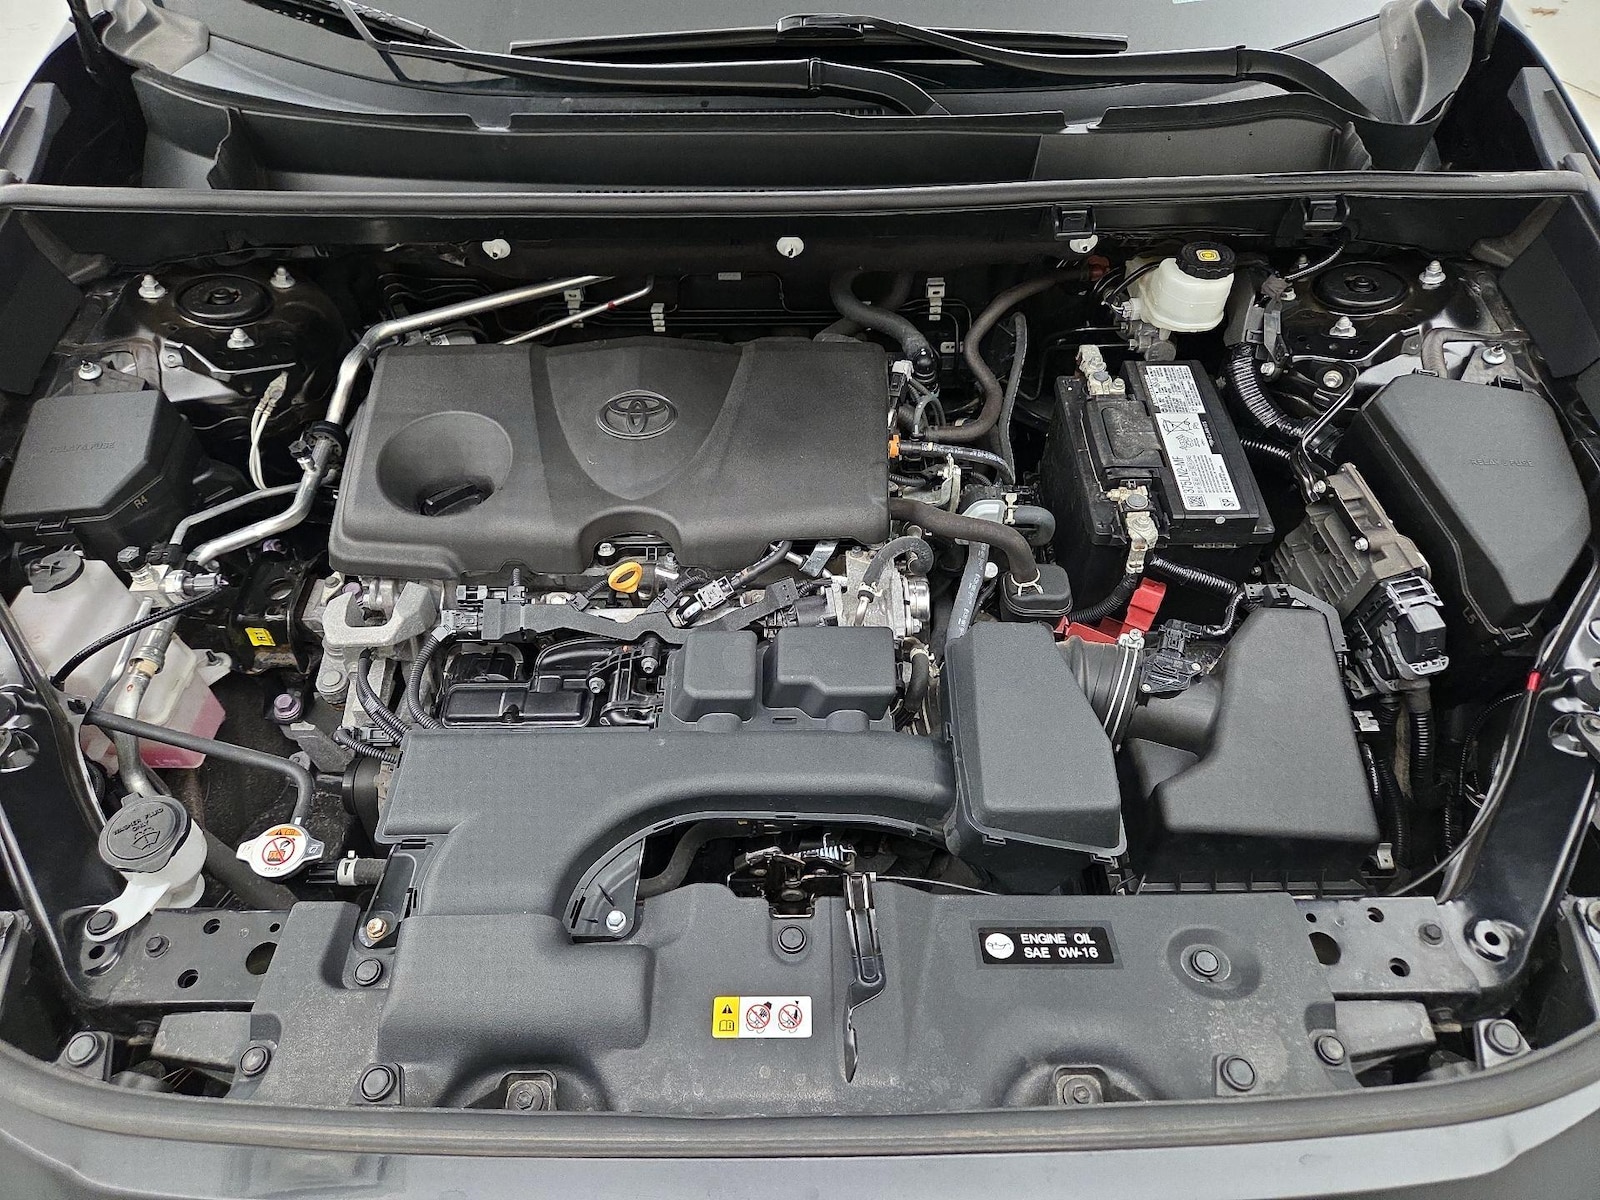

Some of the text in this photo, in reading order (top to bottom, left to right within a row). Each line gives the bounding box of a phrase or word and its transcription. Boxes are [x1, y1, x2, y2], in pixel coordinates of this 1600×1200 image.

[1172, 455, 1195, 493] 375LN2-MF
[133, 495, 149, 509] R4
[1221, 498, 1235, 507] SP
[113, 807, 164, 836] WASHER FLUID
[132, 820, 149, 832] ONLY
[1020, 933, 1096, 945] ENGINE OIL
[1024, 947, 1099, 959] SAE 0W-16
